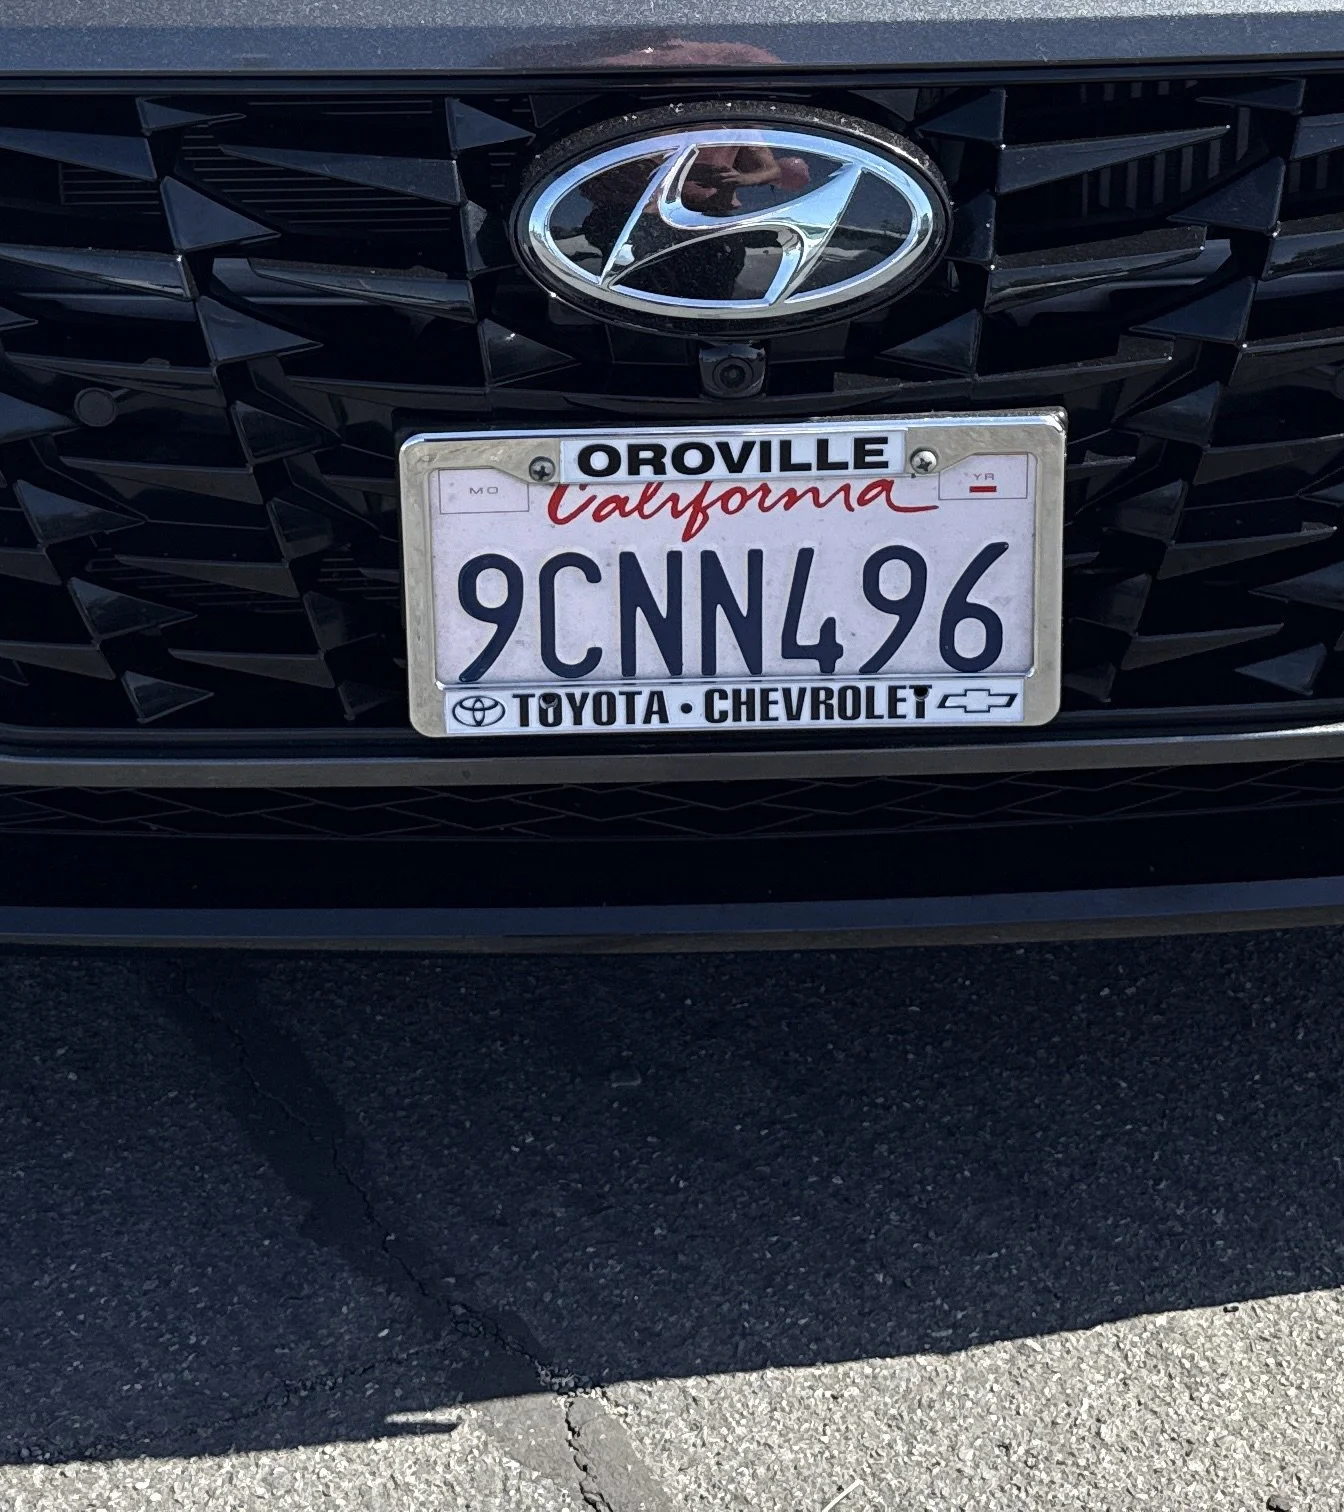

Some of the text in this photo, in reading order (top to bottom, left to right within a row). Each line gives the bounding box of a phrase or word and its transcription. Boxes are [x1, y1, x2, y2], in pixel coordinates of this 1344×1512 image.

[577, 436, 890, 478] OROVILLE
[973, 472, 995, 481] YR
[469, 486, 499, 495] MO
[548, 479, 940, 543] California
[457, 541, 1010, 683] 9CNN496
[511, 684, 933, 728] TOYOTA CHEVROLET
